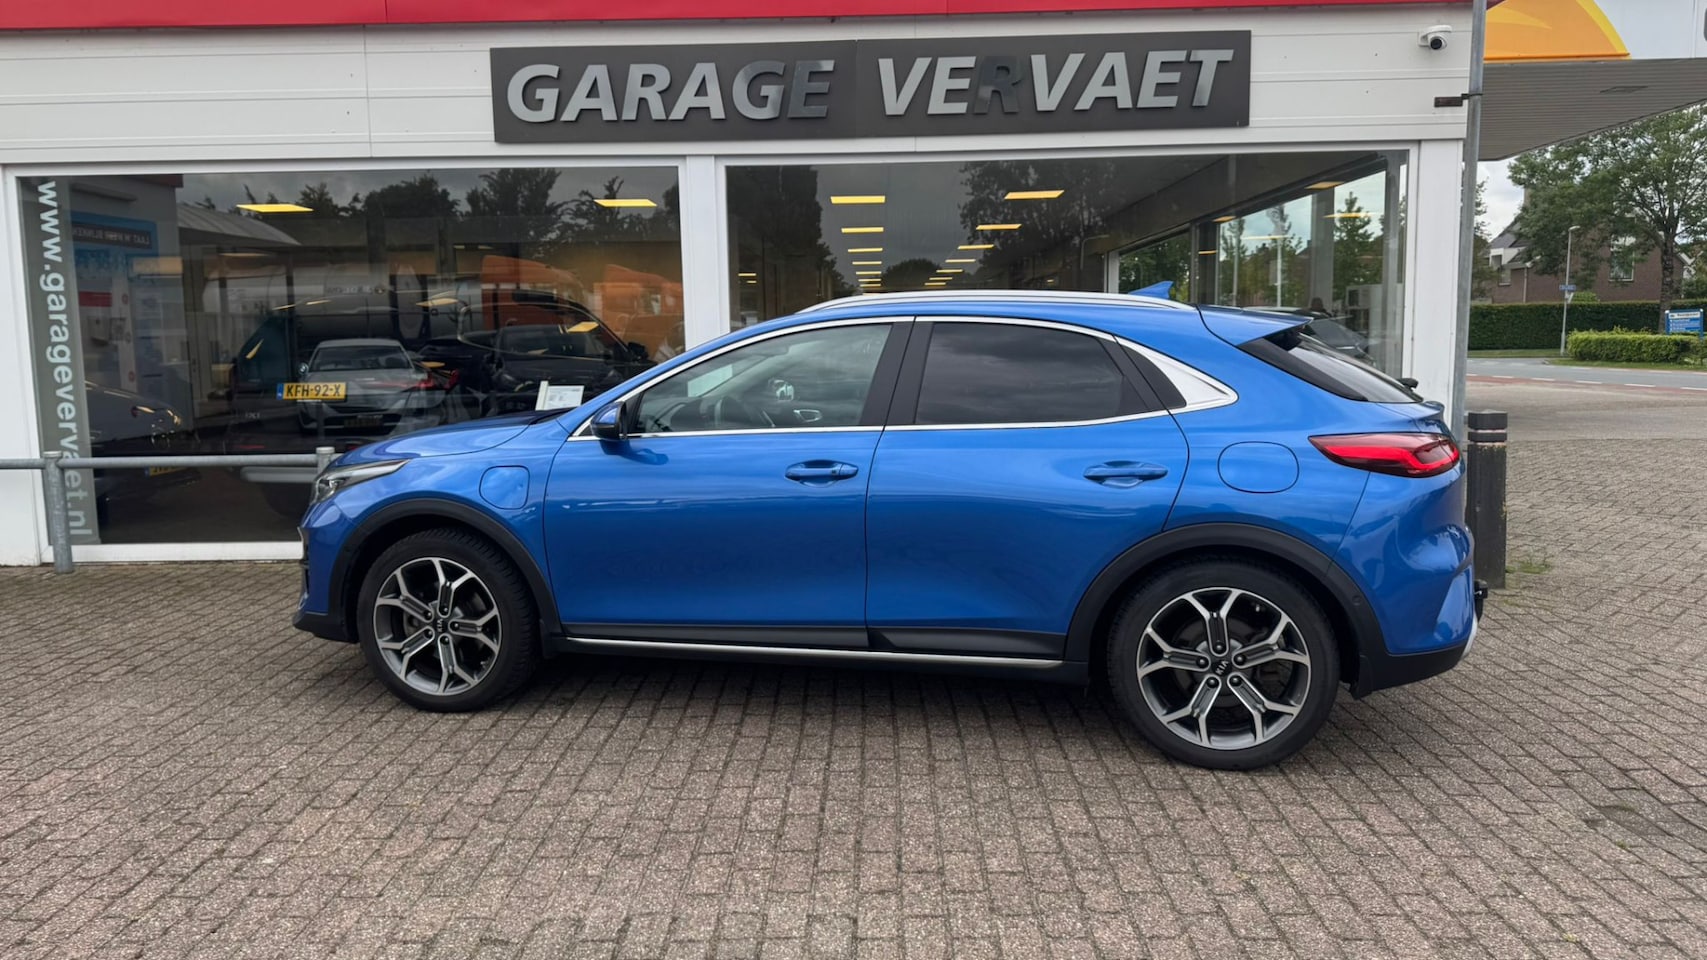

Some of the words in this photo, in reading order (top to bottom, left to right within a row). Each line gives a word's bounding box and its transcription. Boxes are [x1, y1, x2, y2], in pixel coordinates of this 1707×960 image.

[507, 60, 835, 122] GARAGE
[877, 48, 1234, 117] VERVAET
[286, 383, 341, 397] KFH-92-X
[1215, 660, 1229, 676] KIA
